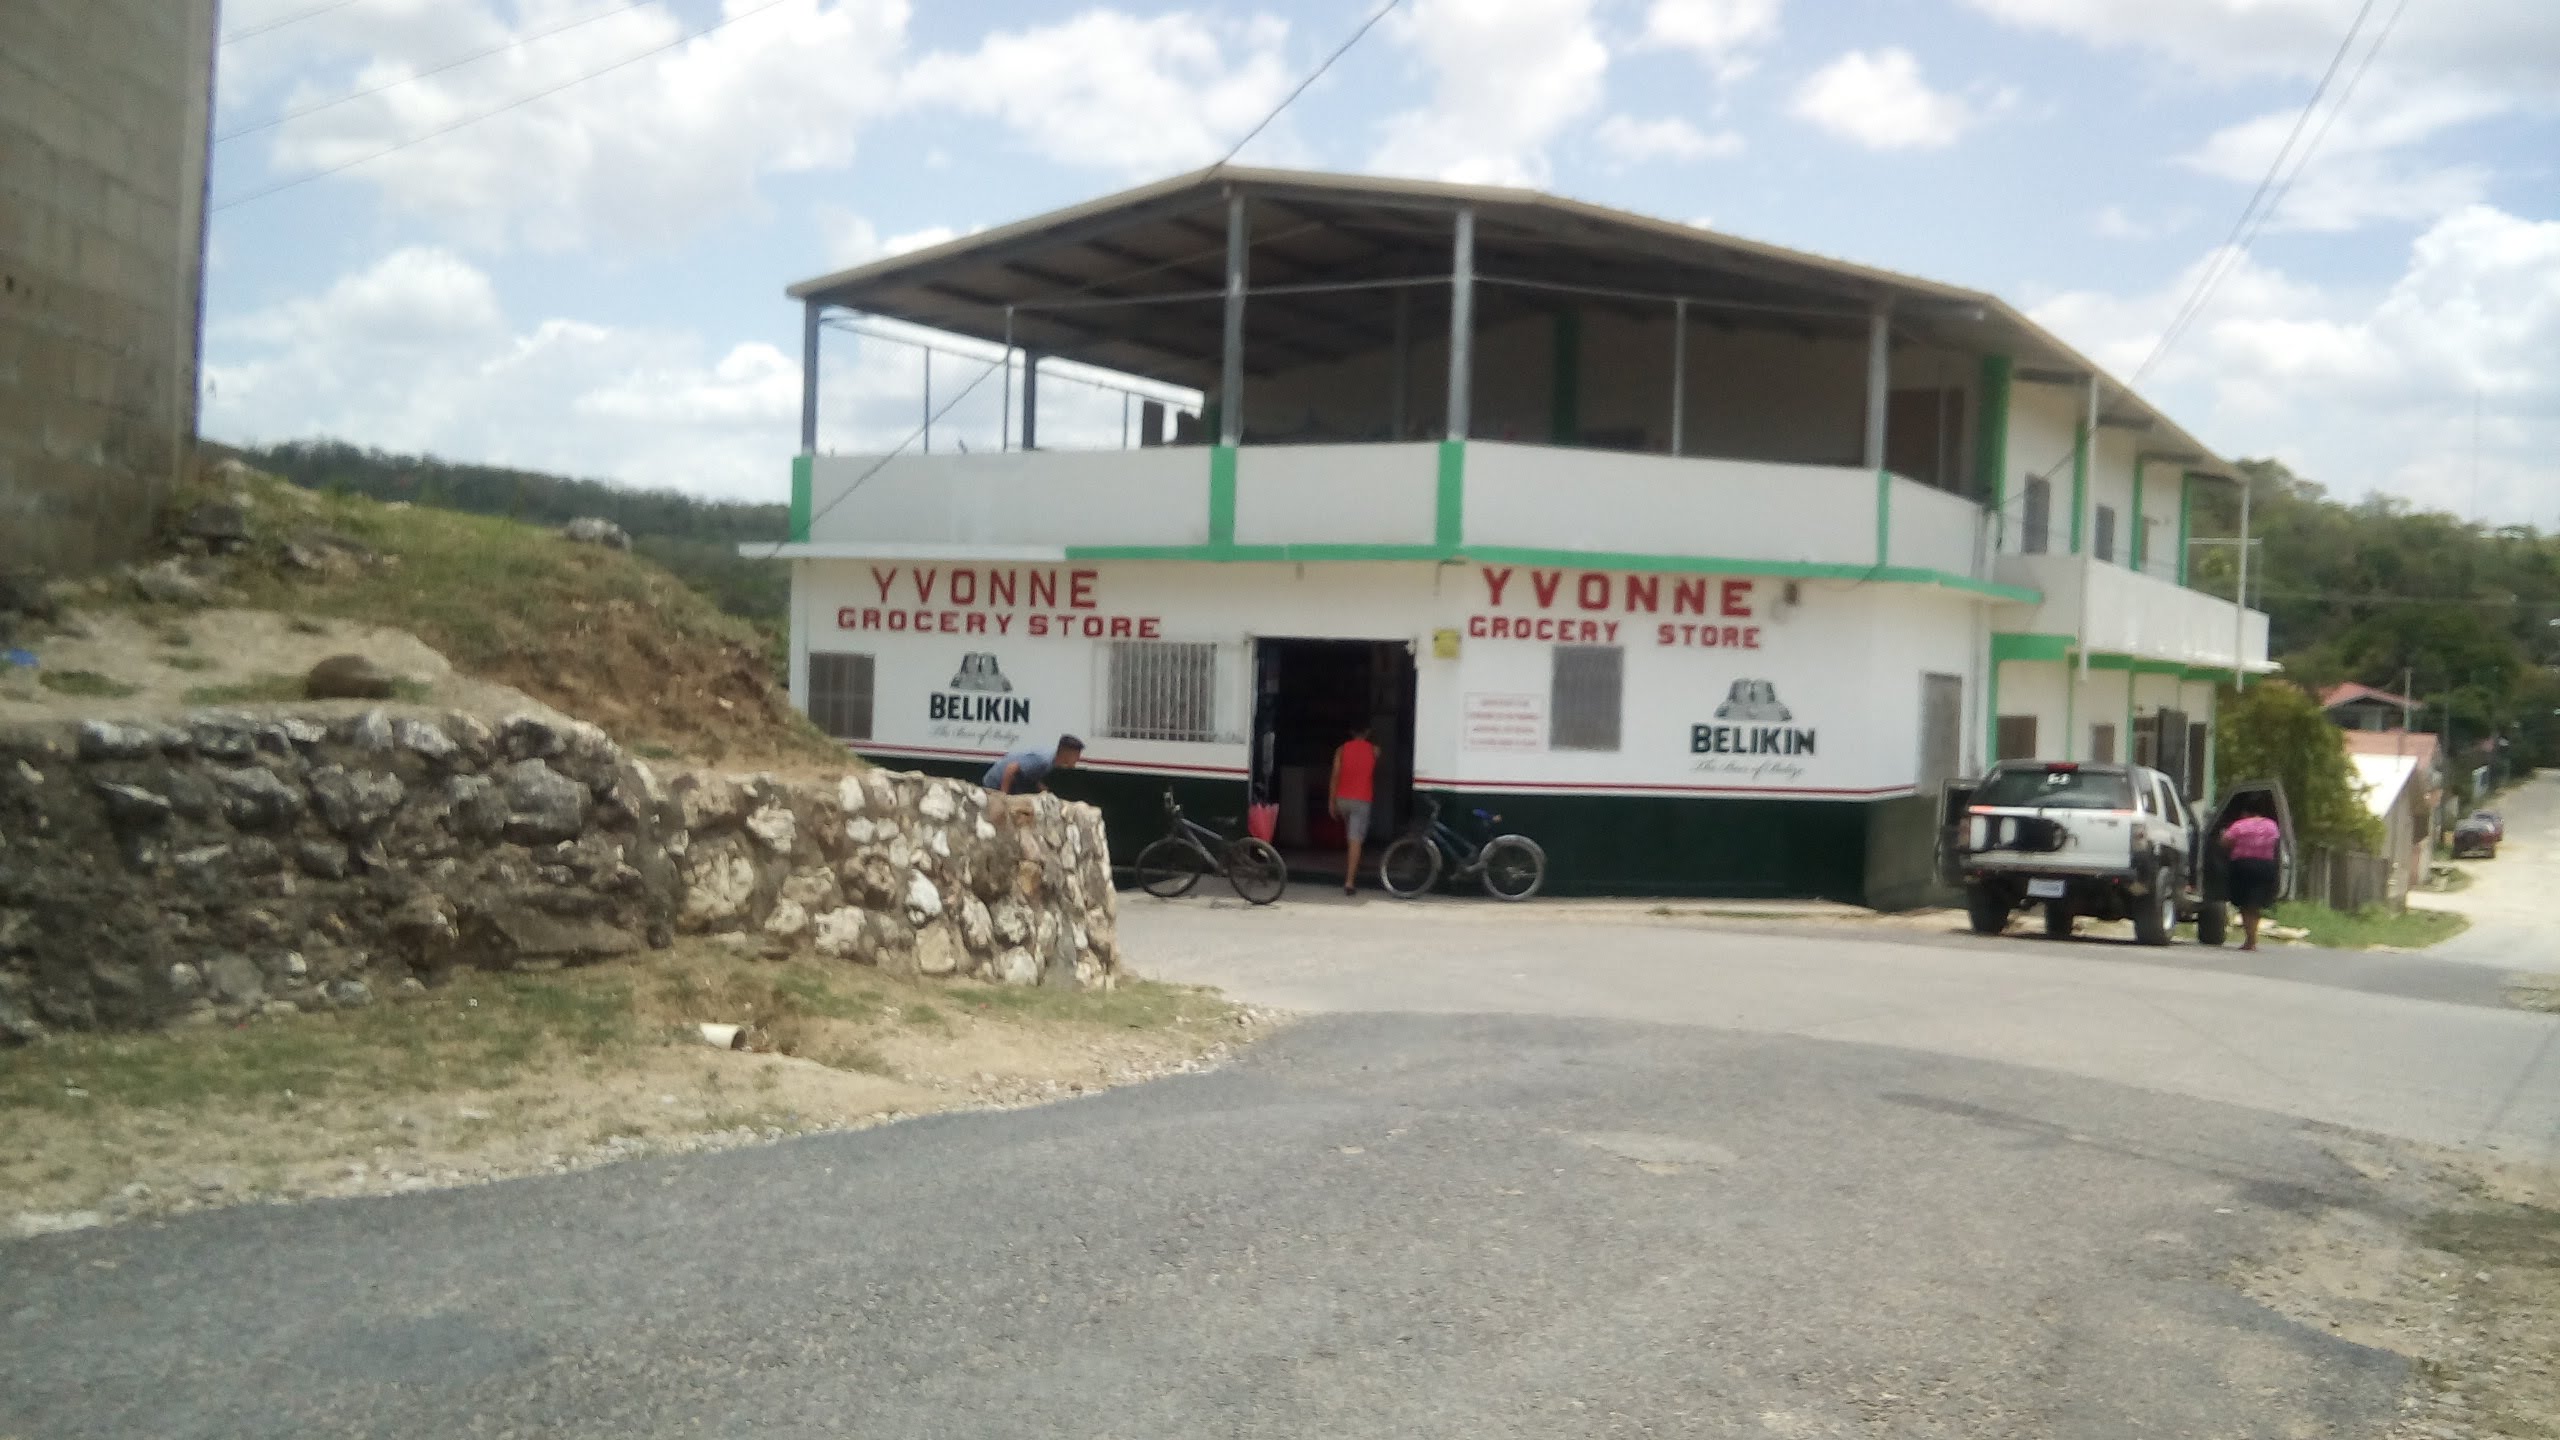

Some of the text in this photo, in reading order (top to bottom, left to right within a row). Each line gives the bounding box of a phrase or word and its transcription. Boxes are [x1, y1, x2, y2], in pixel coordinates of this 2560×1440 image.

[871, 567, 1098, 608] YVONNE
[1483, 568, 1753, 616] YVONNE
[837, 607, 1161, 639] GROCERY STORE
[1468, 615, 1762, 649] GROCERY STORE
[929, 692, 1030, 724] BELIKIN
[1690, 724, 1816, 755] BELIKIN
